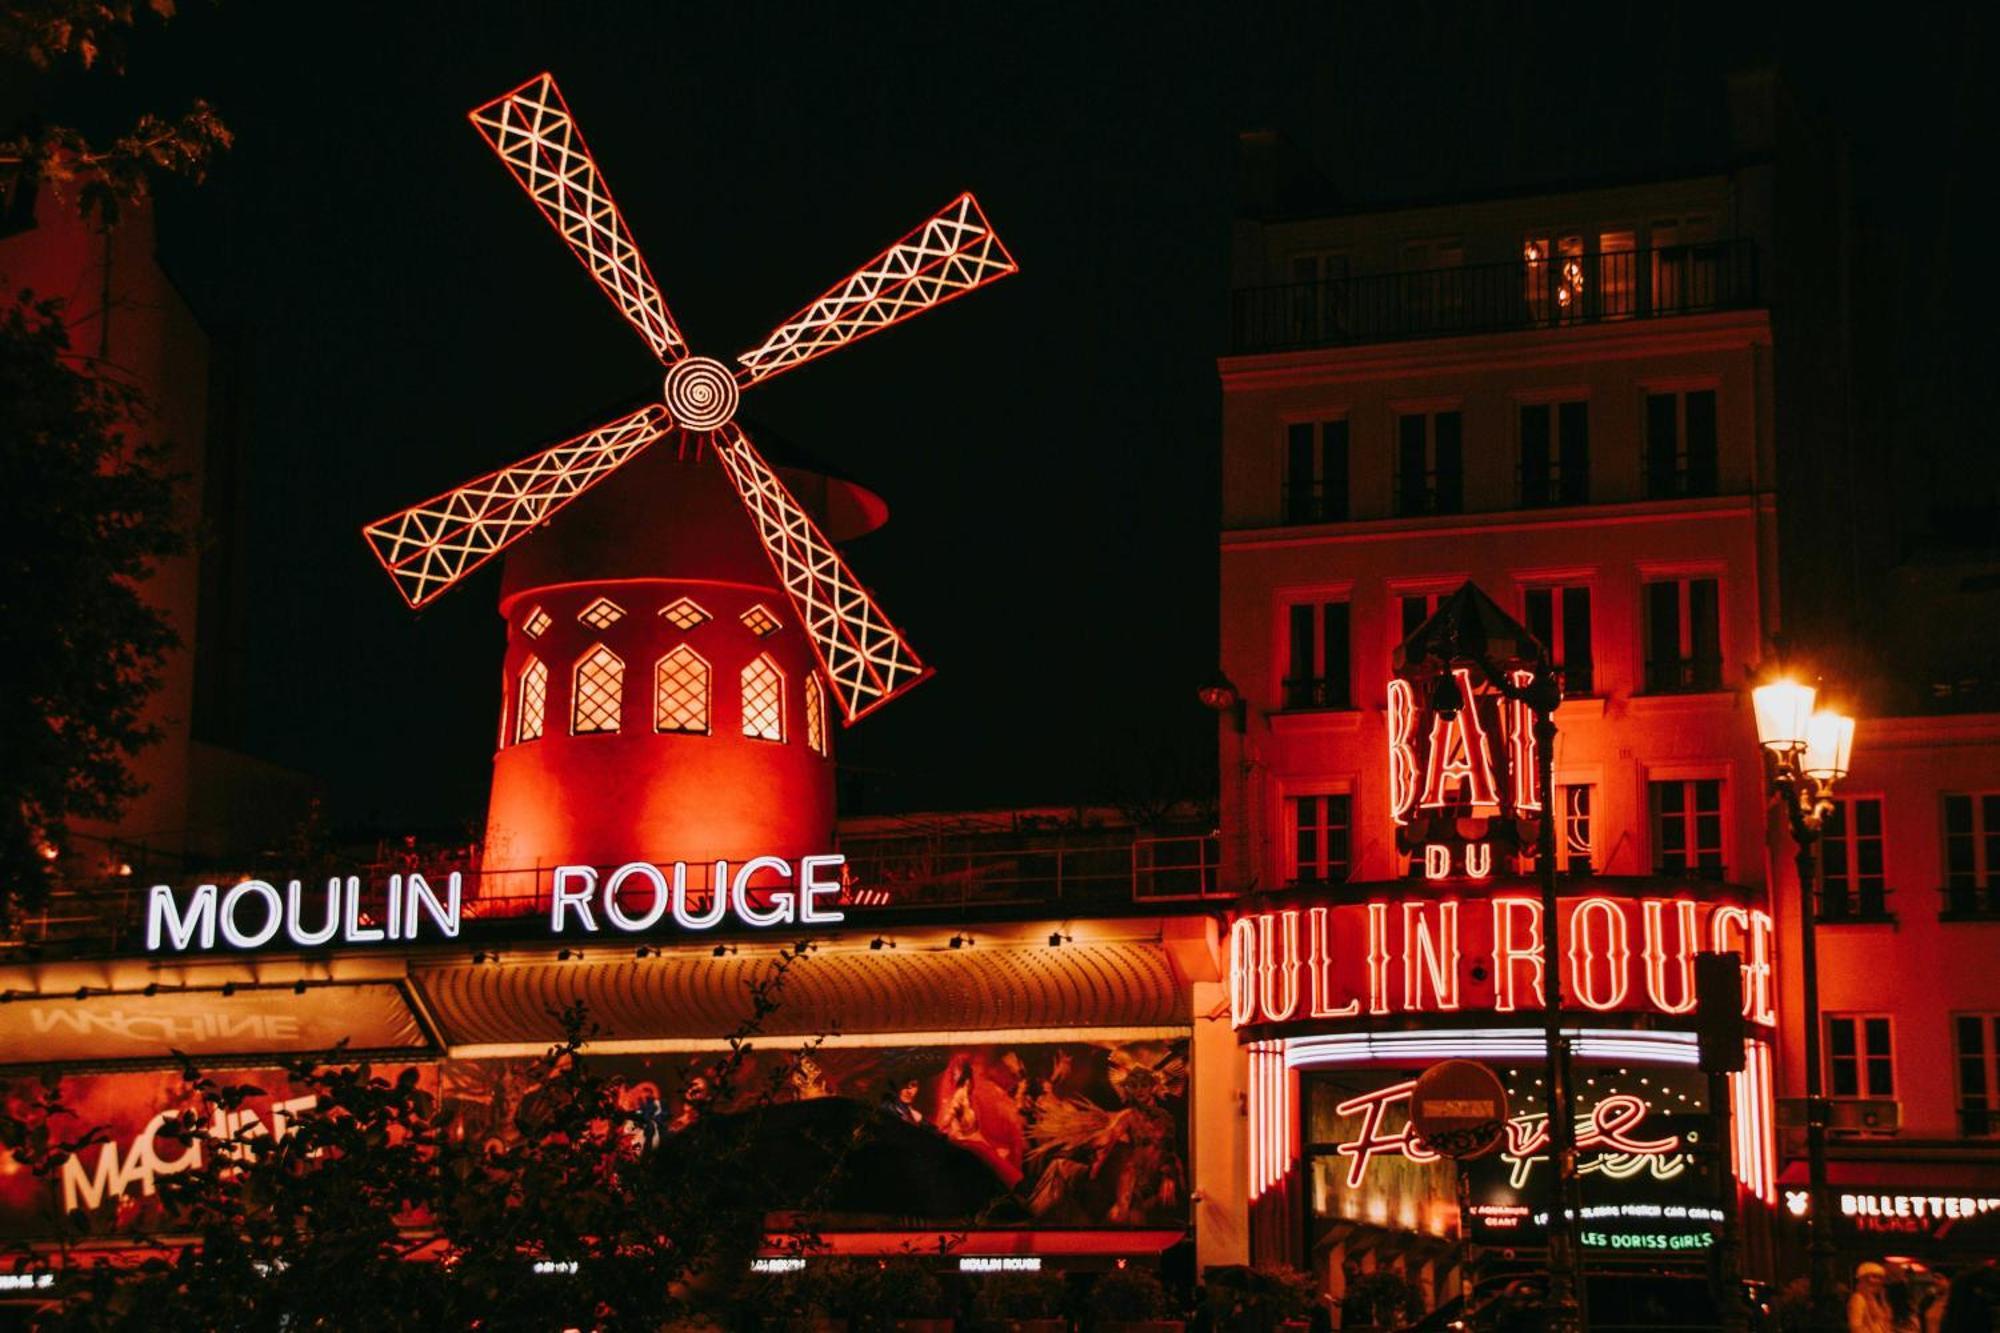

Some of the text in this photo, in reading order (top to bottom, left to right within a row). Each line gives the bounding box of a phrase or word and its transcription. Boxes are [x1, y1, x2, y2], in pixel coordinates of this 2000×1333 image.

[1425, 843, 1491, 880] DU
[146, 853, 846, 951] MOULIN ROUGE
[1230, 898, 1777, 1030] OULIN ROUGE
[1841, 1194, 2000, 1219] BILLETTERI
[1581, 1232, 1607, 1246] LES
[1611, 1234, 1667, 1248] DORISS
